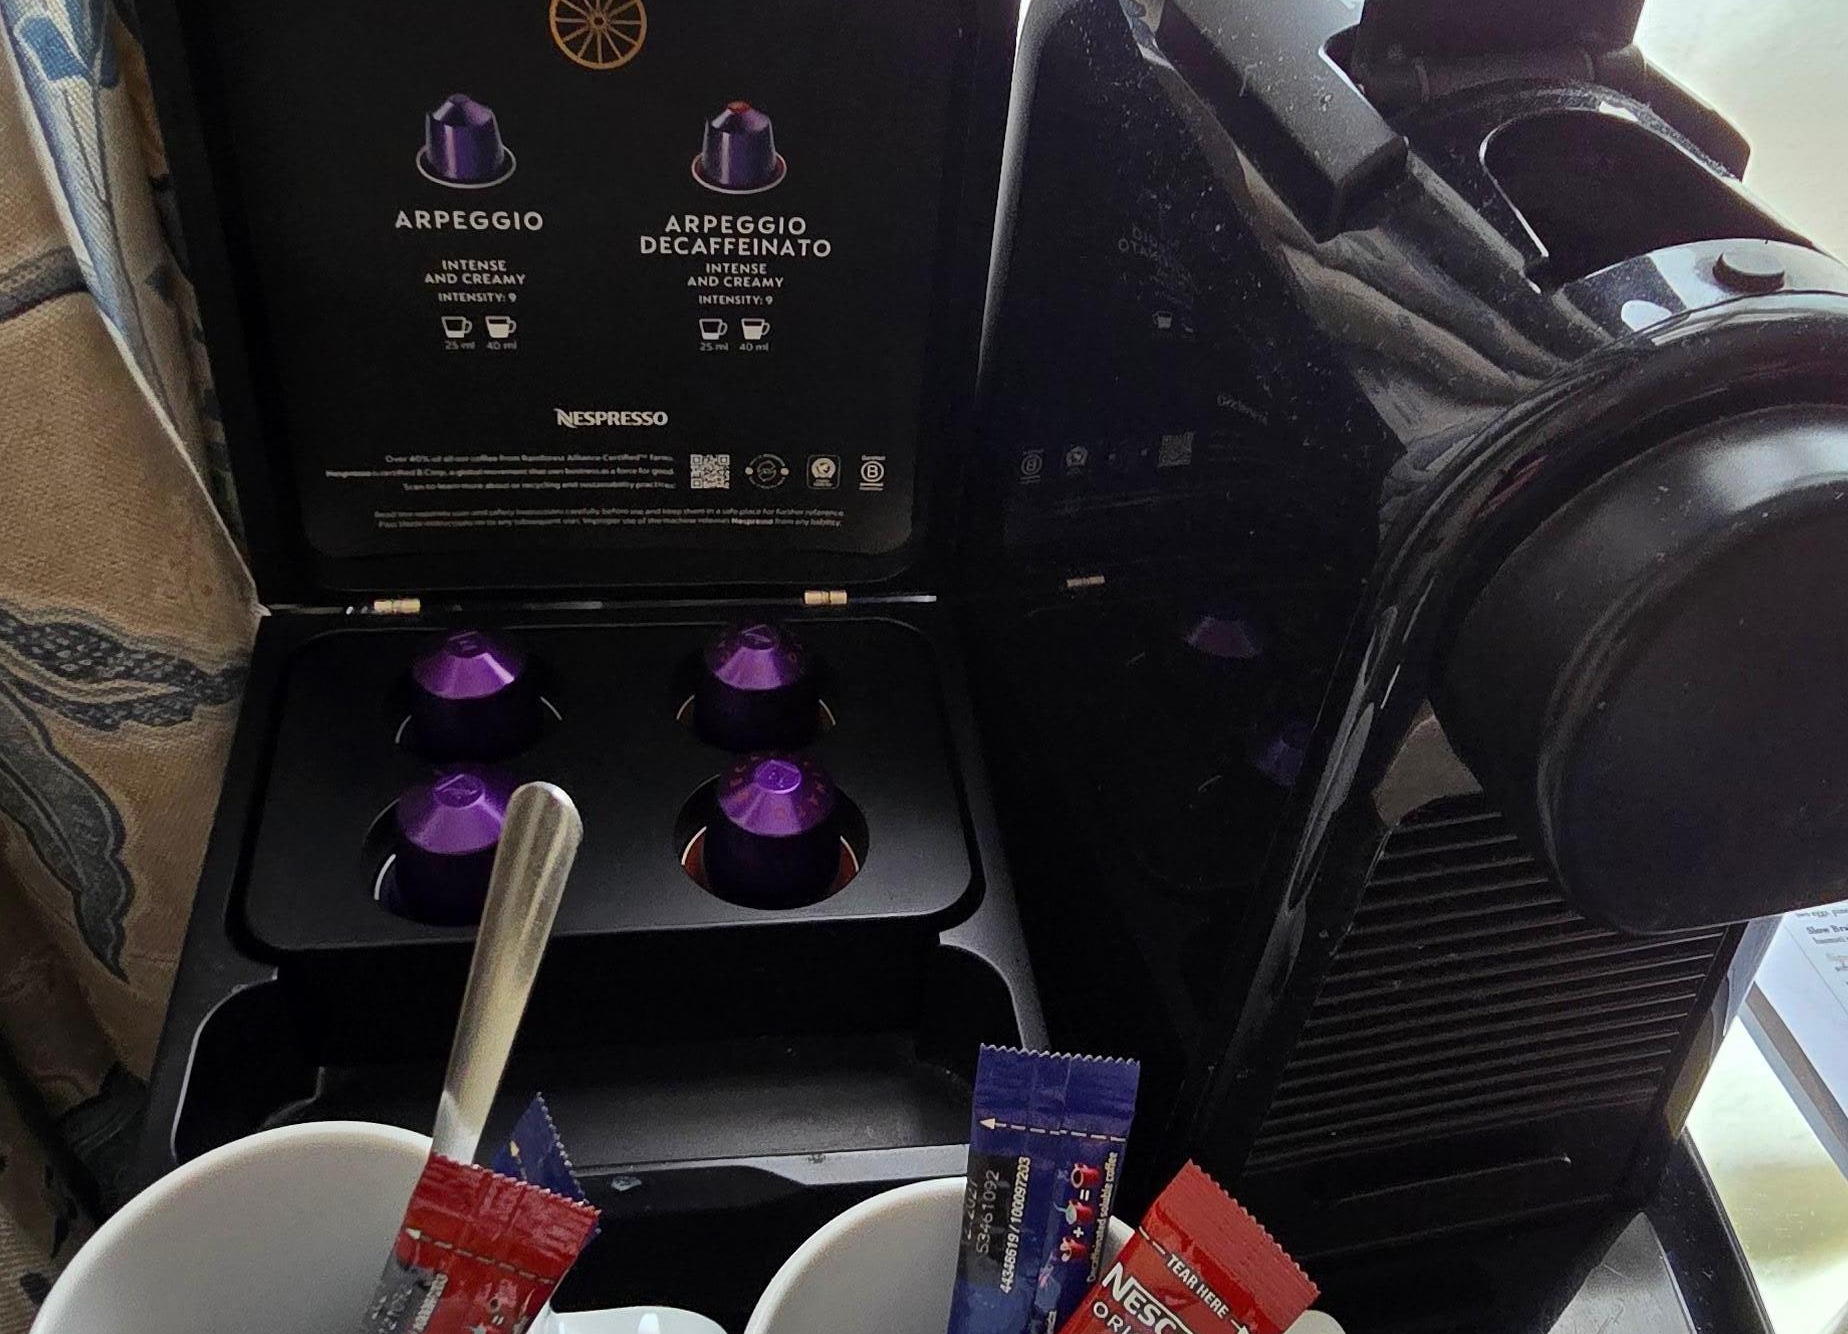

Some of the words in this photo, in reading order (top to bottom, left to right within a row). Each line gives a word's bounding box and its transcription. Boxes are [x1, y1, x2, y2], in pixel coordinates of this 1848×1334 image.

[394, 209, 544, 231] ARPEGGIO
[664, 214, 807, 235] ARPEGGIO
[640, 235, 832, 258] DECAFFEINATO
[442, 259, 507, 272] INTENSE
[705, 262, 767, 275] INTENSE
[424, 272, 458, 284] AND
[461, 273, 526, 285] CREAMY
[687, 275, 720, 287] AND
[723, 276, 784, 288] CREAMY
[438, 292, 506, 303] INTENSITY:
[508, 293, 517, 303] 9
[698, 295, 763, 306] INTENSITY:
[765, 297, 773, 306] 9
[700, 342, 714, 352] 25
[715, 342, 729, 352] ml
[739, 342, 754, 352] 40
[755, 342, 769, 352] ml
[553, 407, 669, 428] NESPRESSO
[1166, 1253, 1199, 1290] TEAR
[1196, 1283, 1230, 1320] HERE
